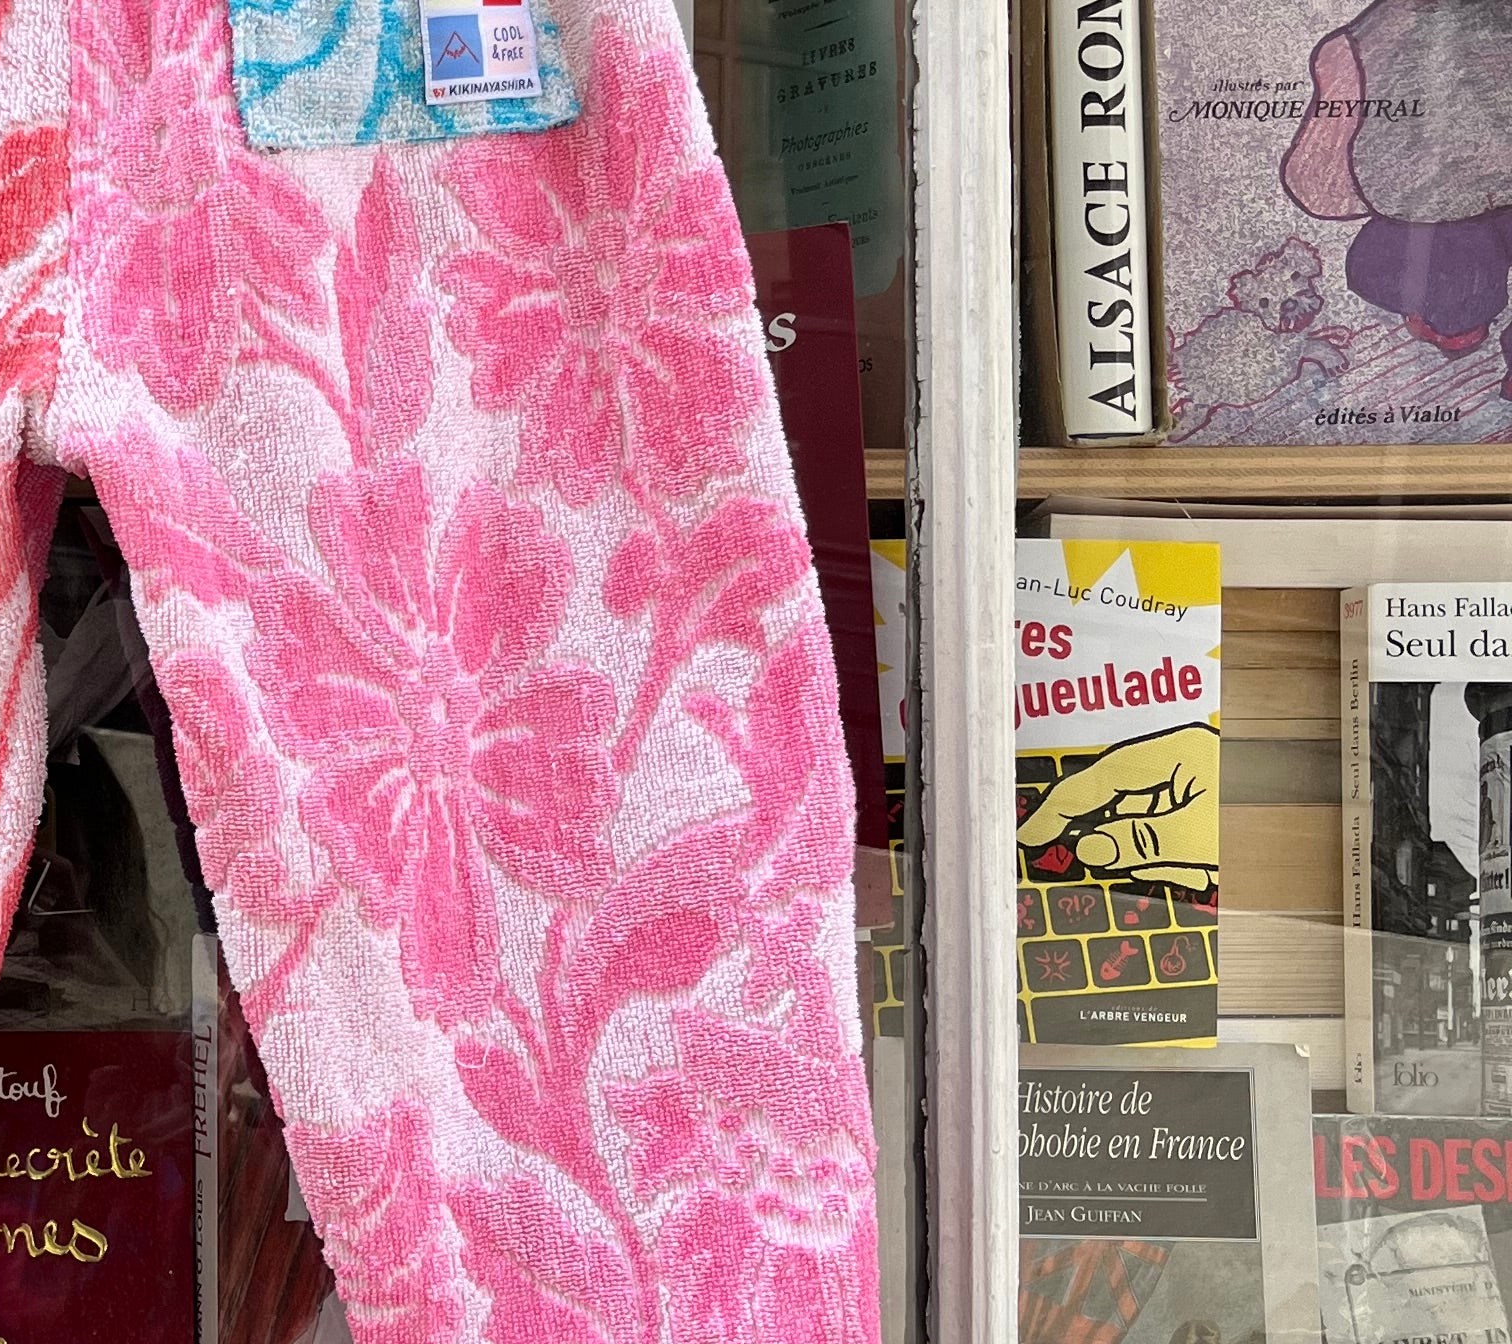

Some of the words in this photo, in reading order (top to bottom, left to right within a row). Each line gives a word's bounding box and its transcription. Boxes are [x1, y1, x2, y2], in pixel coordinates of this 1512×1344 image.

[493, 25, 524, 42] COOL
[432, 86, 446, 98] BY
[777, 60, 878, 104] GRAVURES
[1212, 77, 1270, 93] illustrés
[1274, 80, 1304, 94] par
[1168, 99, 1305, 123] MONIQUE
[1311, 98, 1425, 123] PEYTRAL
[778, 119, 869, 161] Photographies
[1083, 160, 1137, 422] ALSACE
[1315, 406, 1376, 425] édités
[1384, 408, 1395, 424] à
[1400, 405, 1462, 424] Vialot
[1385, 597, 1447, 618] Hans
[1386, 629, 1459, 658] Seul
[1349, 658, 1359, 711] Berlin
[1349, 716, 1360, 758] dans
[1351, 762, 1360, 800] Seul
[1352, 815, 1361, 880] Fallada
[1352, 883, 1361, 928] Hans
[1079, 1009, 1130, 1022] L'ARBRE
[1133, 1011, 1187, 1023] VENGEUR
[1393, 1061, 1439, 1088] folio
[1017, 1080, 1114, 1116] Histoire
[1120, 1080, 1154, 1115] de
[1025, 1205, 1065, 1225] JEAN
[1070, 1206, 1143, 1225] GUIFFAN
